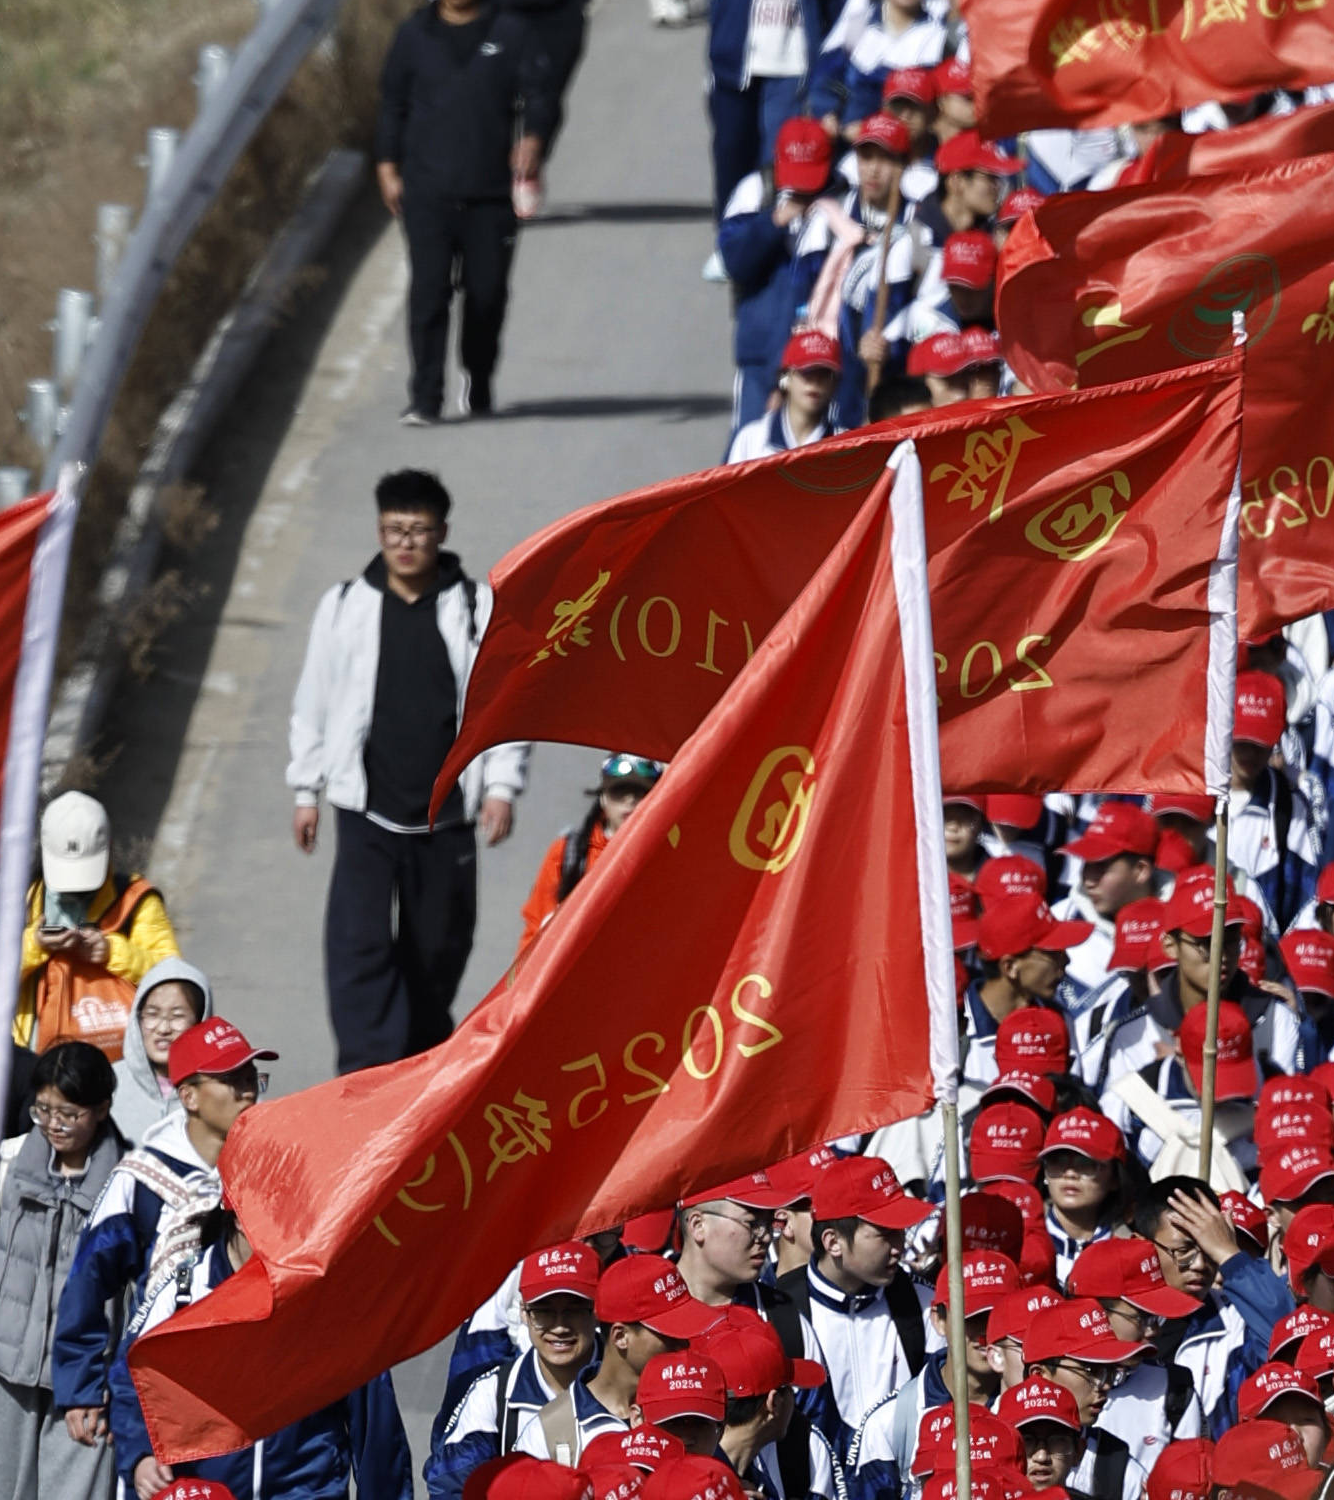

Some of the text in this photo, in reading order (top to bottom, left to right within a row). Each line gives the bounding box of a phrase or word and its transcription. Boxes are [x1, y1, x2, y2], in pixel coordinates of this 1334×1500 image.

[538, 1250, 584, 1268] 固原二中
[964, 1260, 1006, 1278] 固原二中
[1287, 1312, 1330, 1331] 固原二中
[662, 1364, 708, 1382] 固原二中
[670, 1378, 702, 1390] 2025级
[1017, 1383, 1062, 1402] 固原二中
[1024, 1397, 1058, 1409] 2025级
[621, 1432, 670, 1449] 固原二中
